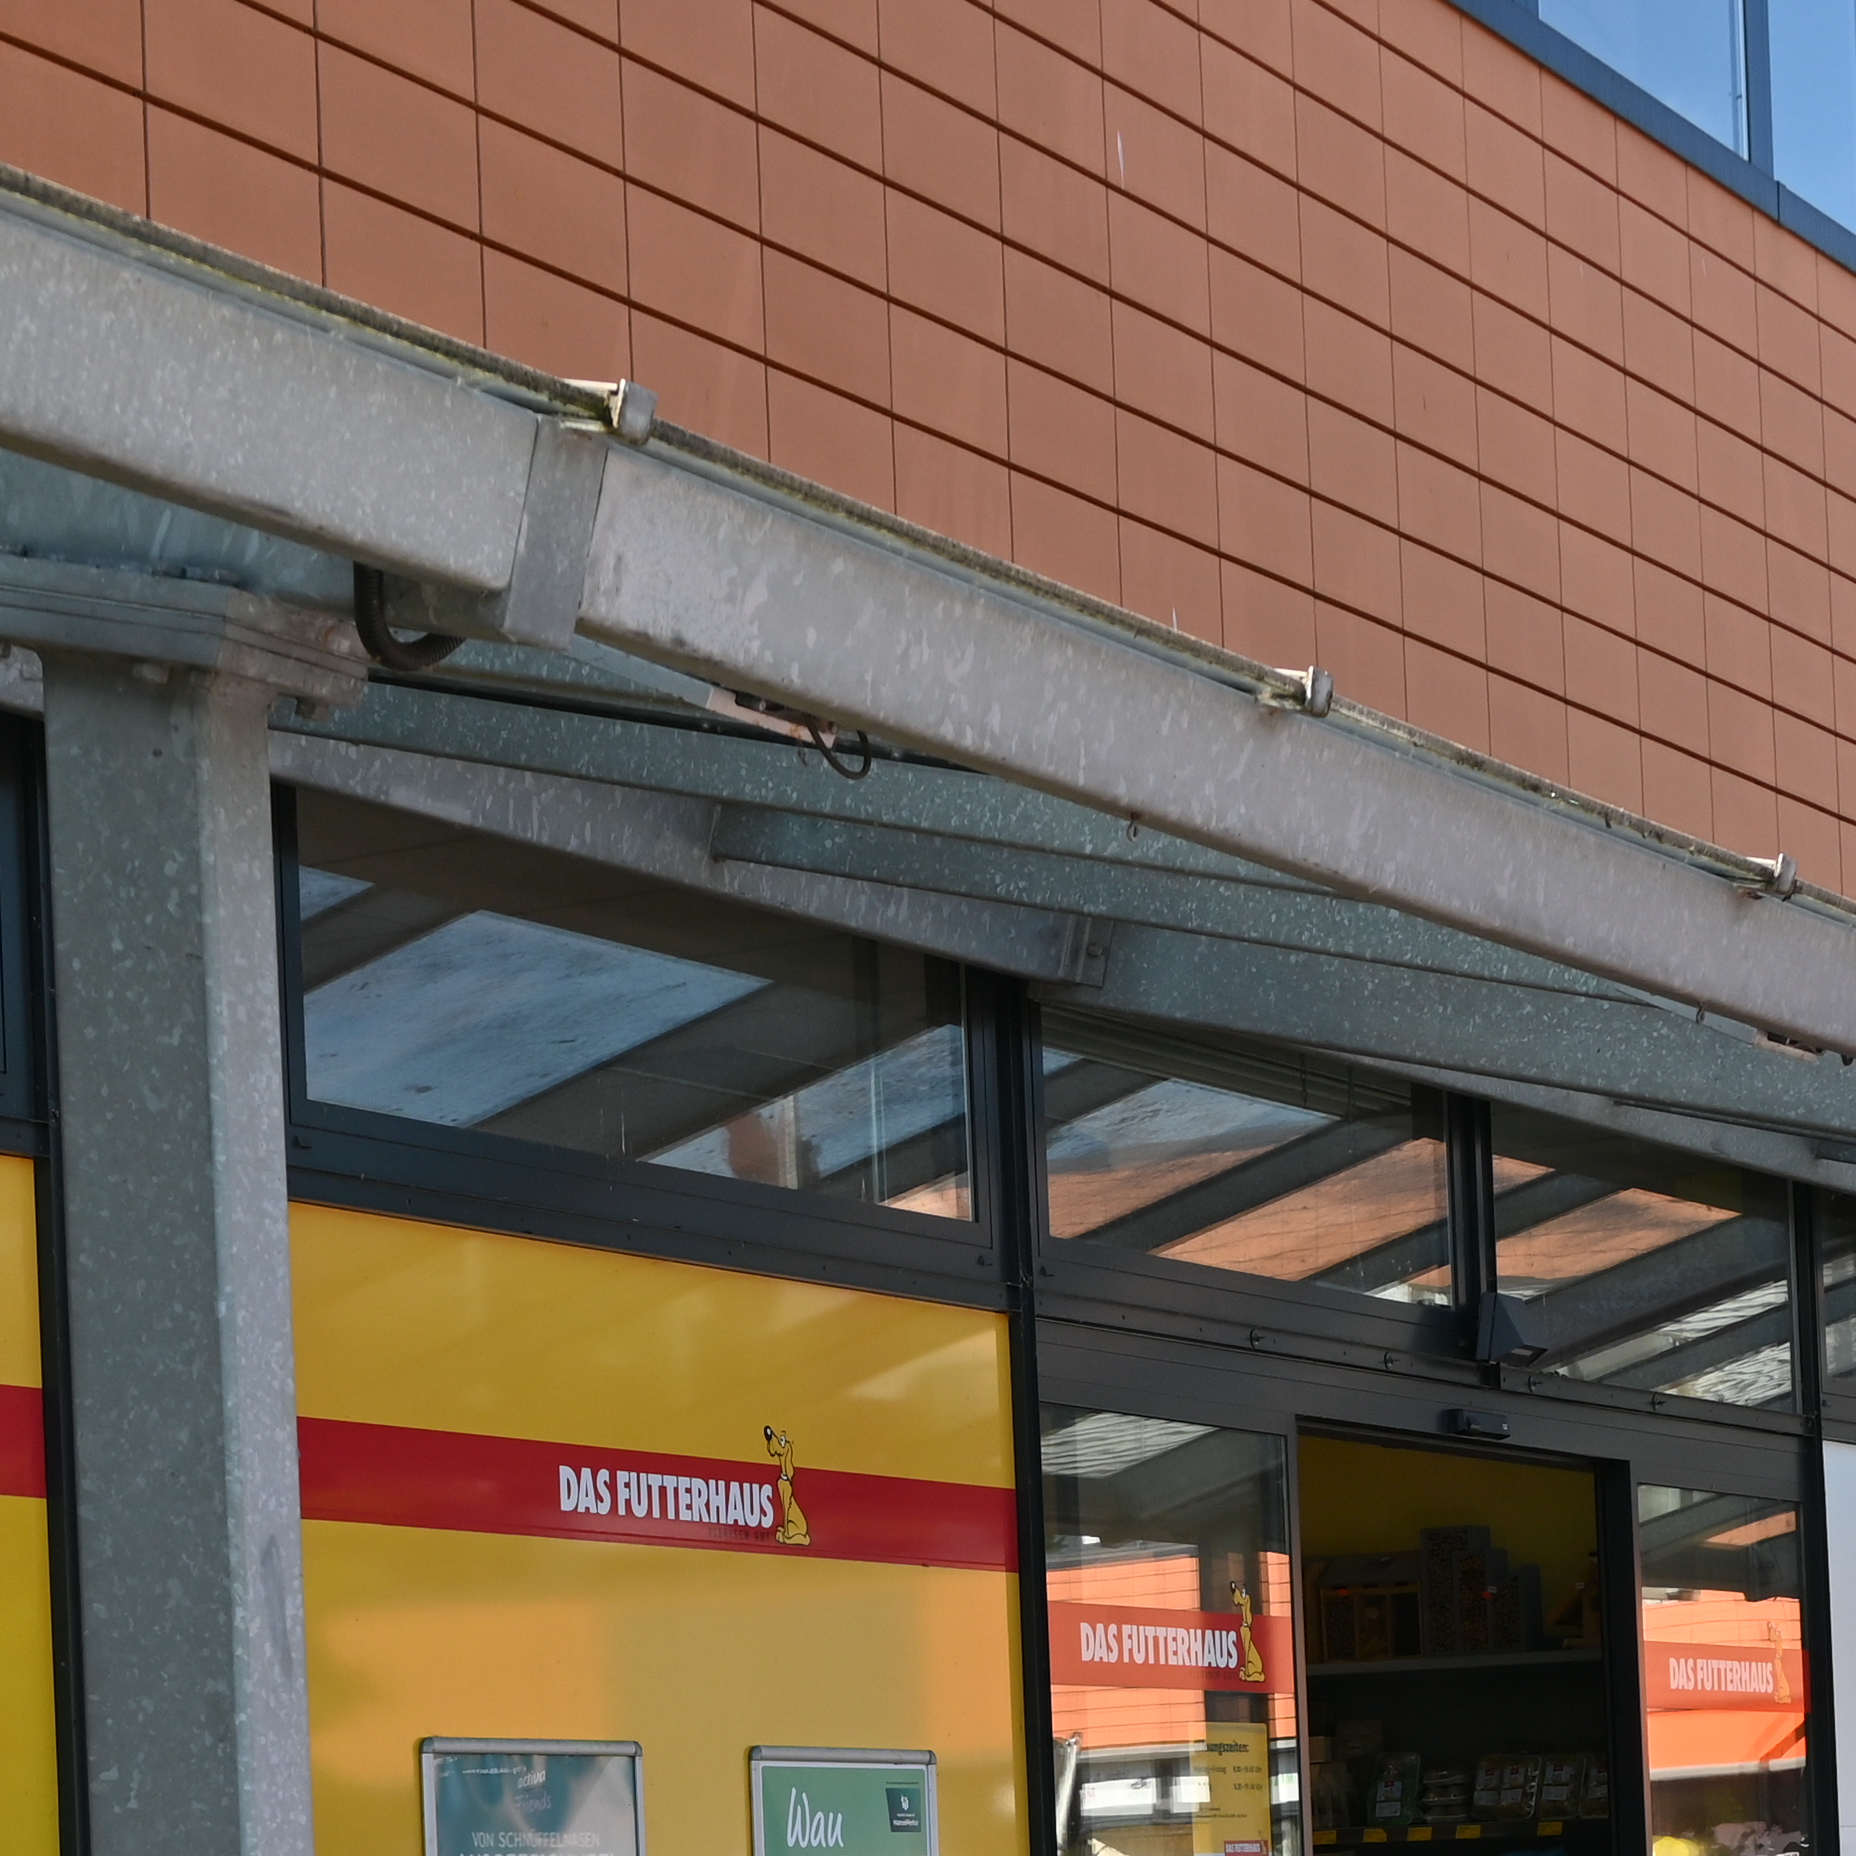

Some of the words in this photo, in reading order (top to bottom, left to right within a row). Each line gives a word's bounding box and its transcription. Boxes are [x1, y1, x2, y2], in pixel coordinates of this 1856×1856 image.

[558, 1465, 611, 1515] DAS
[616, 1470, 774, 1529] FUTTERHAUS
[1080, 1622, 1119, 1664] DAS
[1122, 1625, 1238, 1669] FUTTERHAUS
[1669, 1657, 1695, 1691] DAS
[1696, 1658, 1774, 1695] FUTTERHAUS
[517, 1770, 547, 1789] activa
[471, 1831, 495, 1848] VON
[498, 1828, 600, 1848] SCHNÜFFELNASEN
[786, 1787, 844, 1848] Wau
